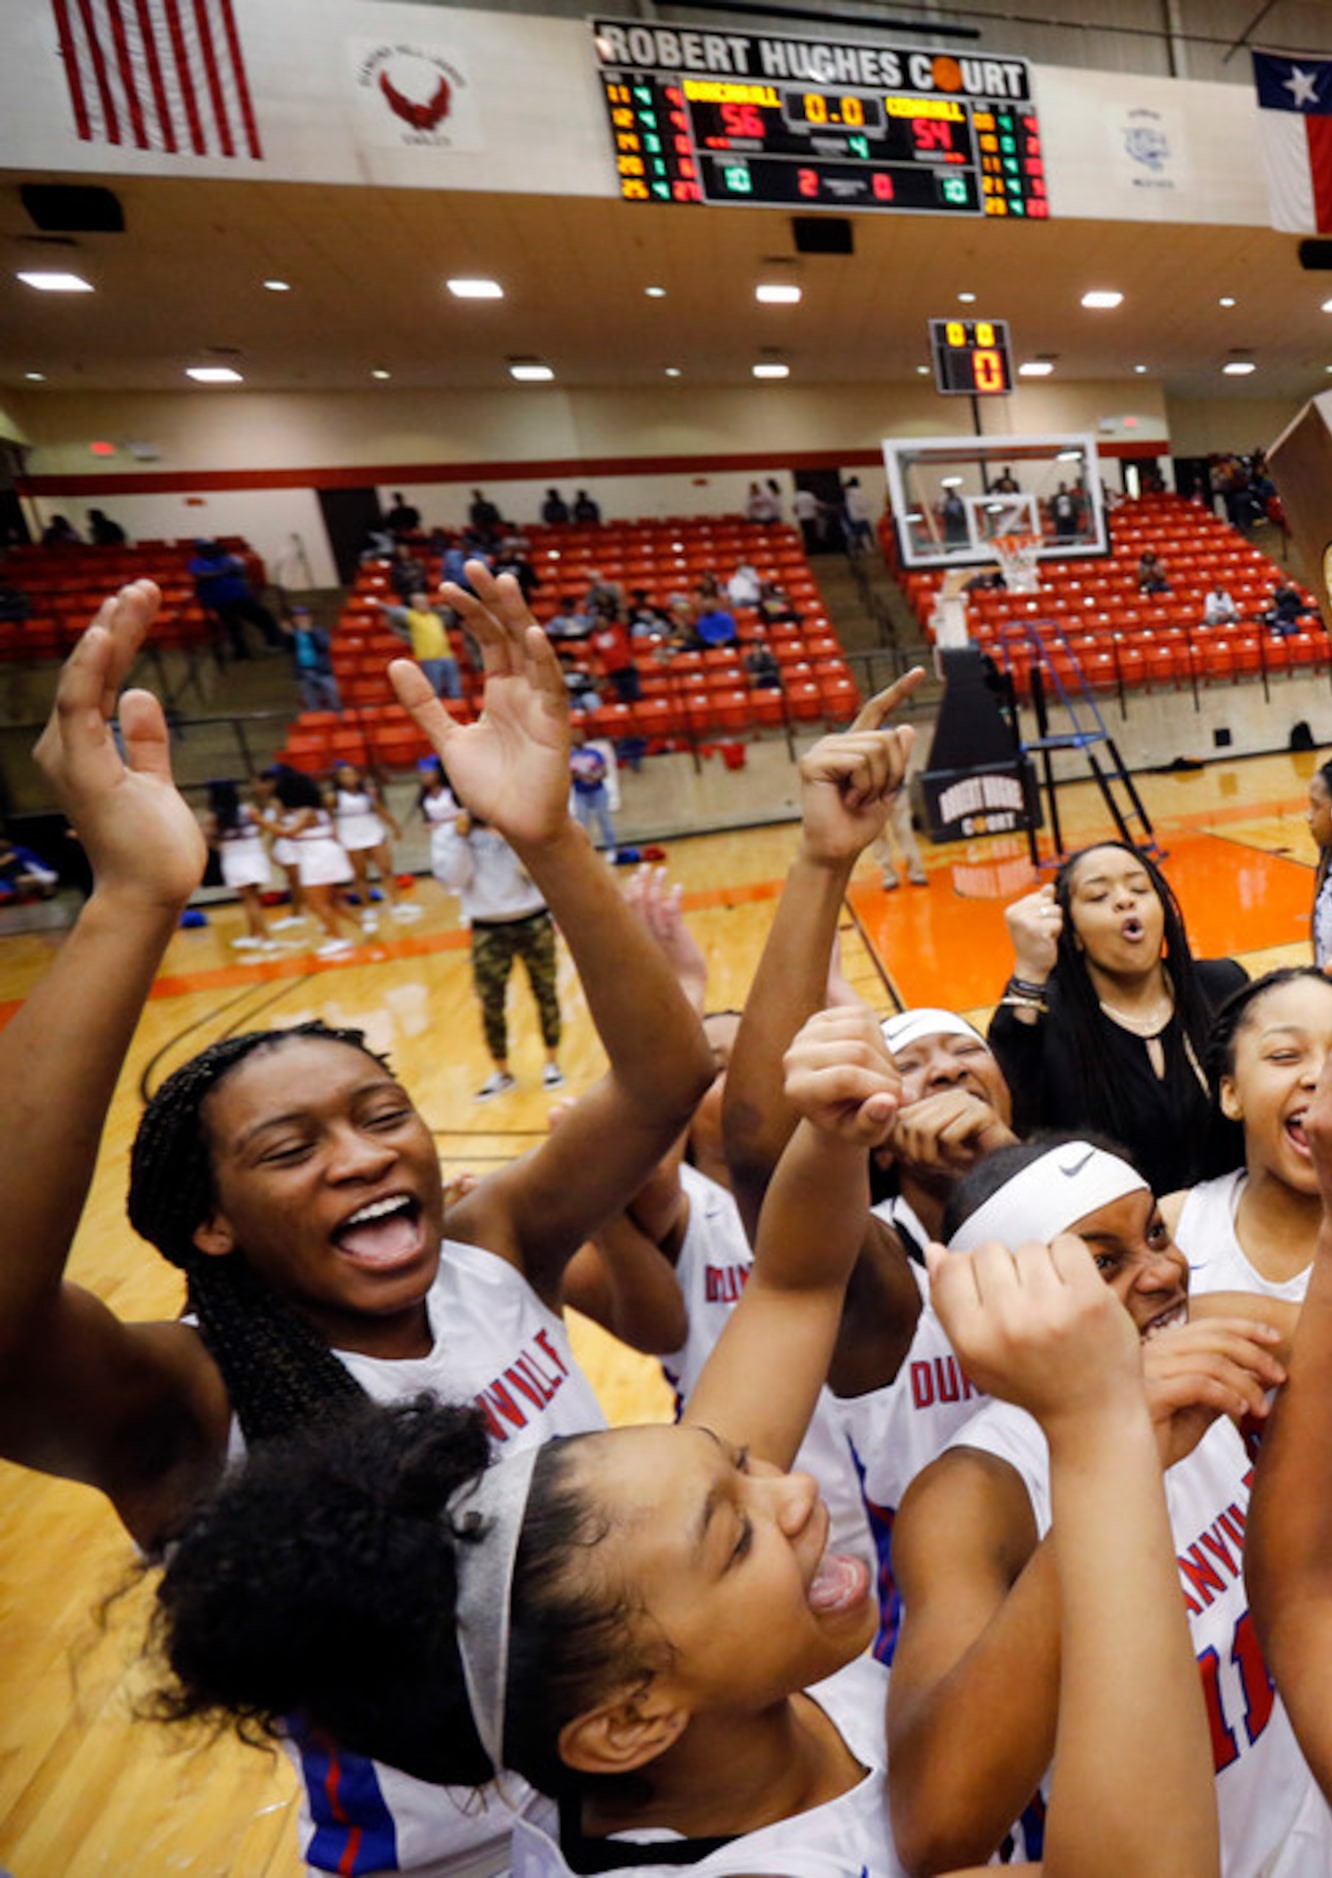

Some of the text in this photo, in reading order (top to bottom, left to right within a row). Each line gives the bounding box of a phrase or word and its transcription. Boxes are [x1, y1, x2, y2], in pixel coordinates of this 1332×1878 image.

[596, 24, 749, 75] ROBERT
[758, 38, 903, 87] HUGHES
[720, 103, 766, 138] 56
[911, 118, 953, 150] 54
[797, 168, 819, 197] 2
[871, 173, 894, 200] 0
[972, 350, 1004, 392] 0
